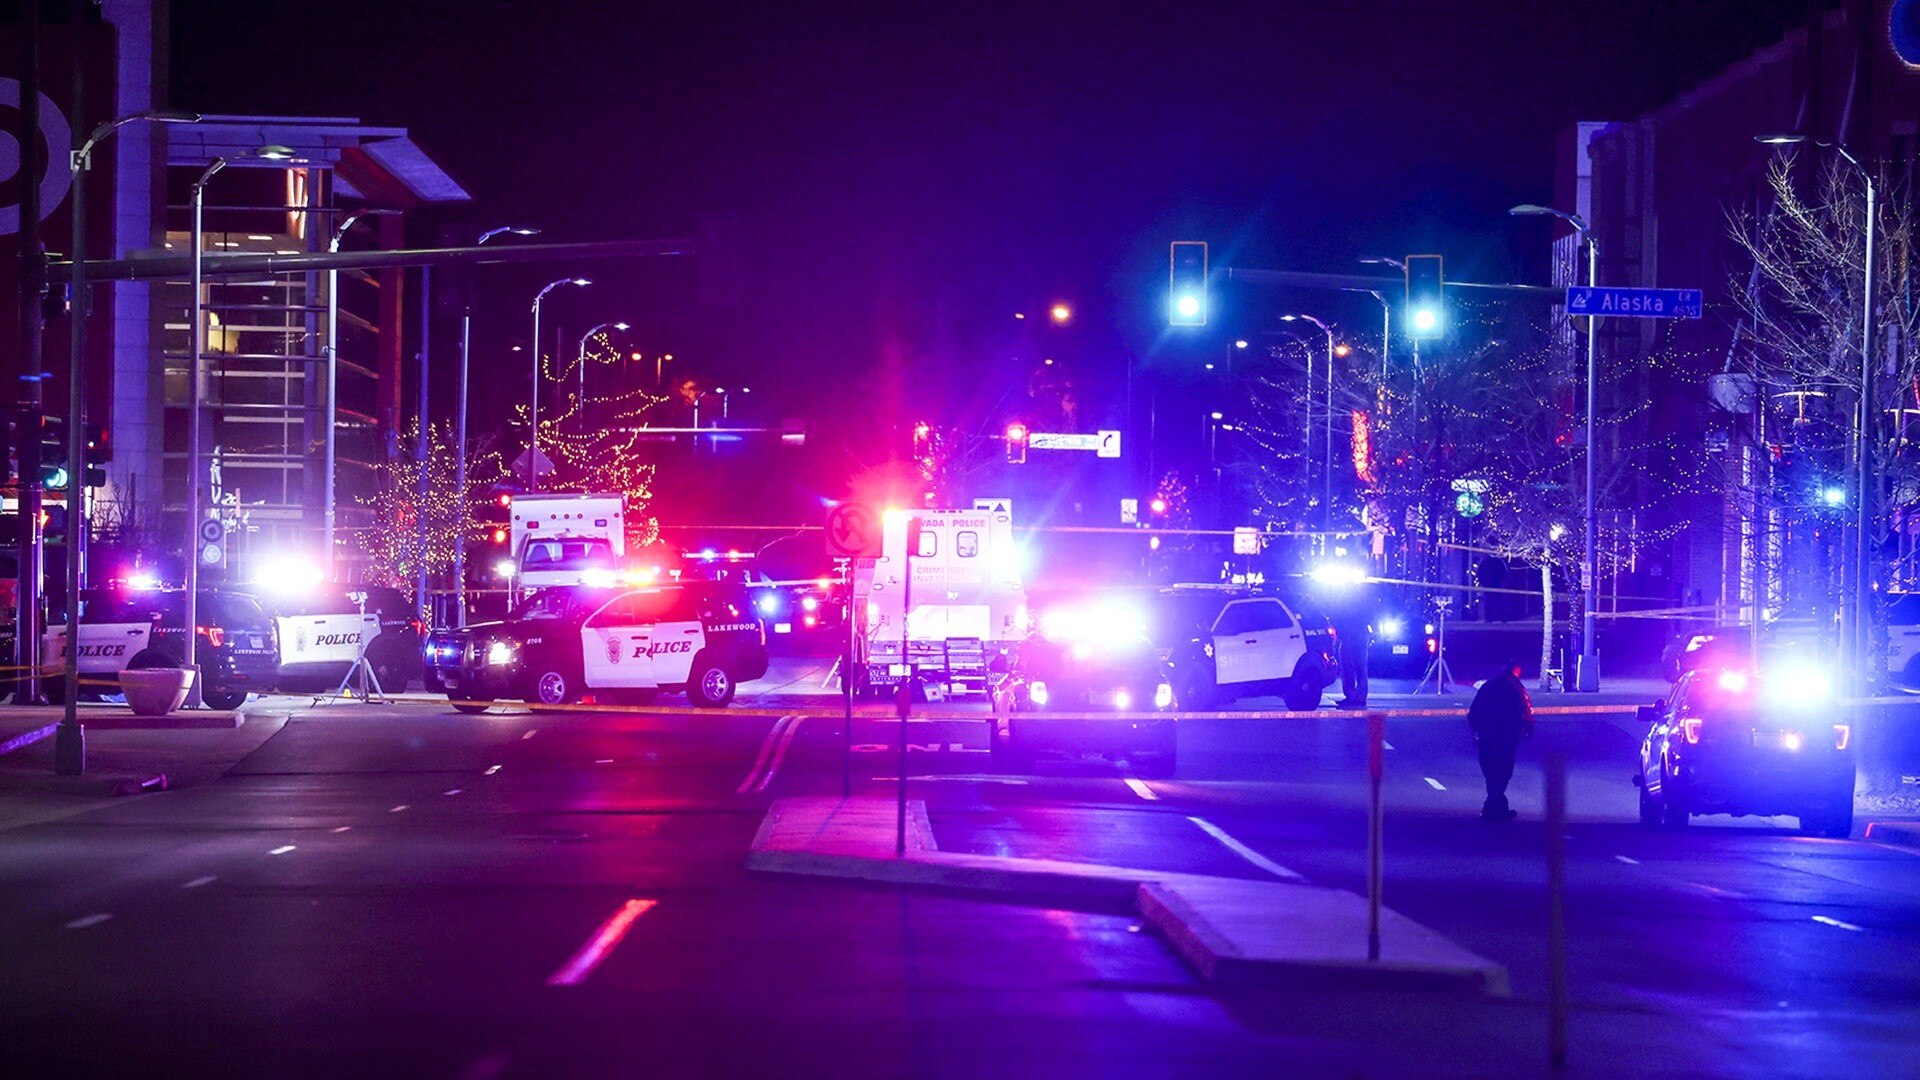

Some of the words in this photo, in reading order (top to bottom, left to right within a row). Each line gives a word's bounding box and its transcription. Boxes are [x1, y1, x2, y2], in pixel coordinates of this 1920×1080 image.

[1601, 293, 1664, 312] Alaska
[919, 519, 945, 527] VADA
[952, 519, 986, 527] POLICE
[917, 566, 945, 574] CRIME
[707, 623, 757, 632] LAKEWOOD
[315, 633, 361, 646] POLICE
[849, 743, 991, 753] ONL
